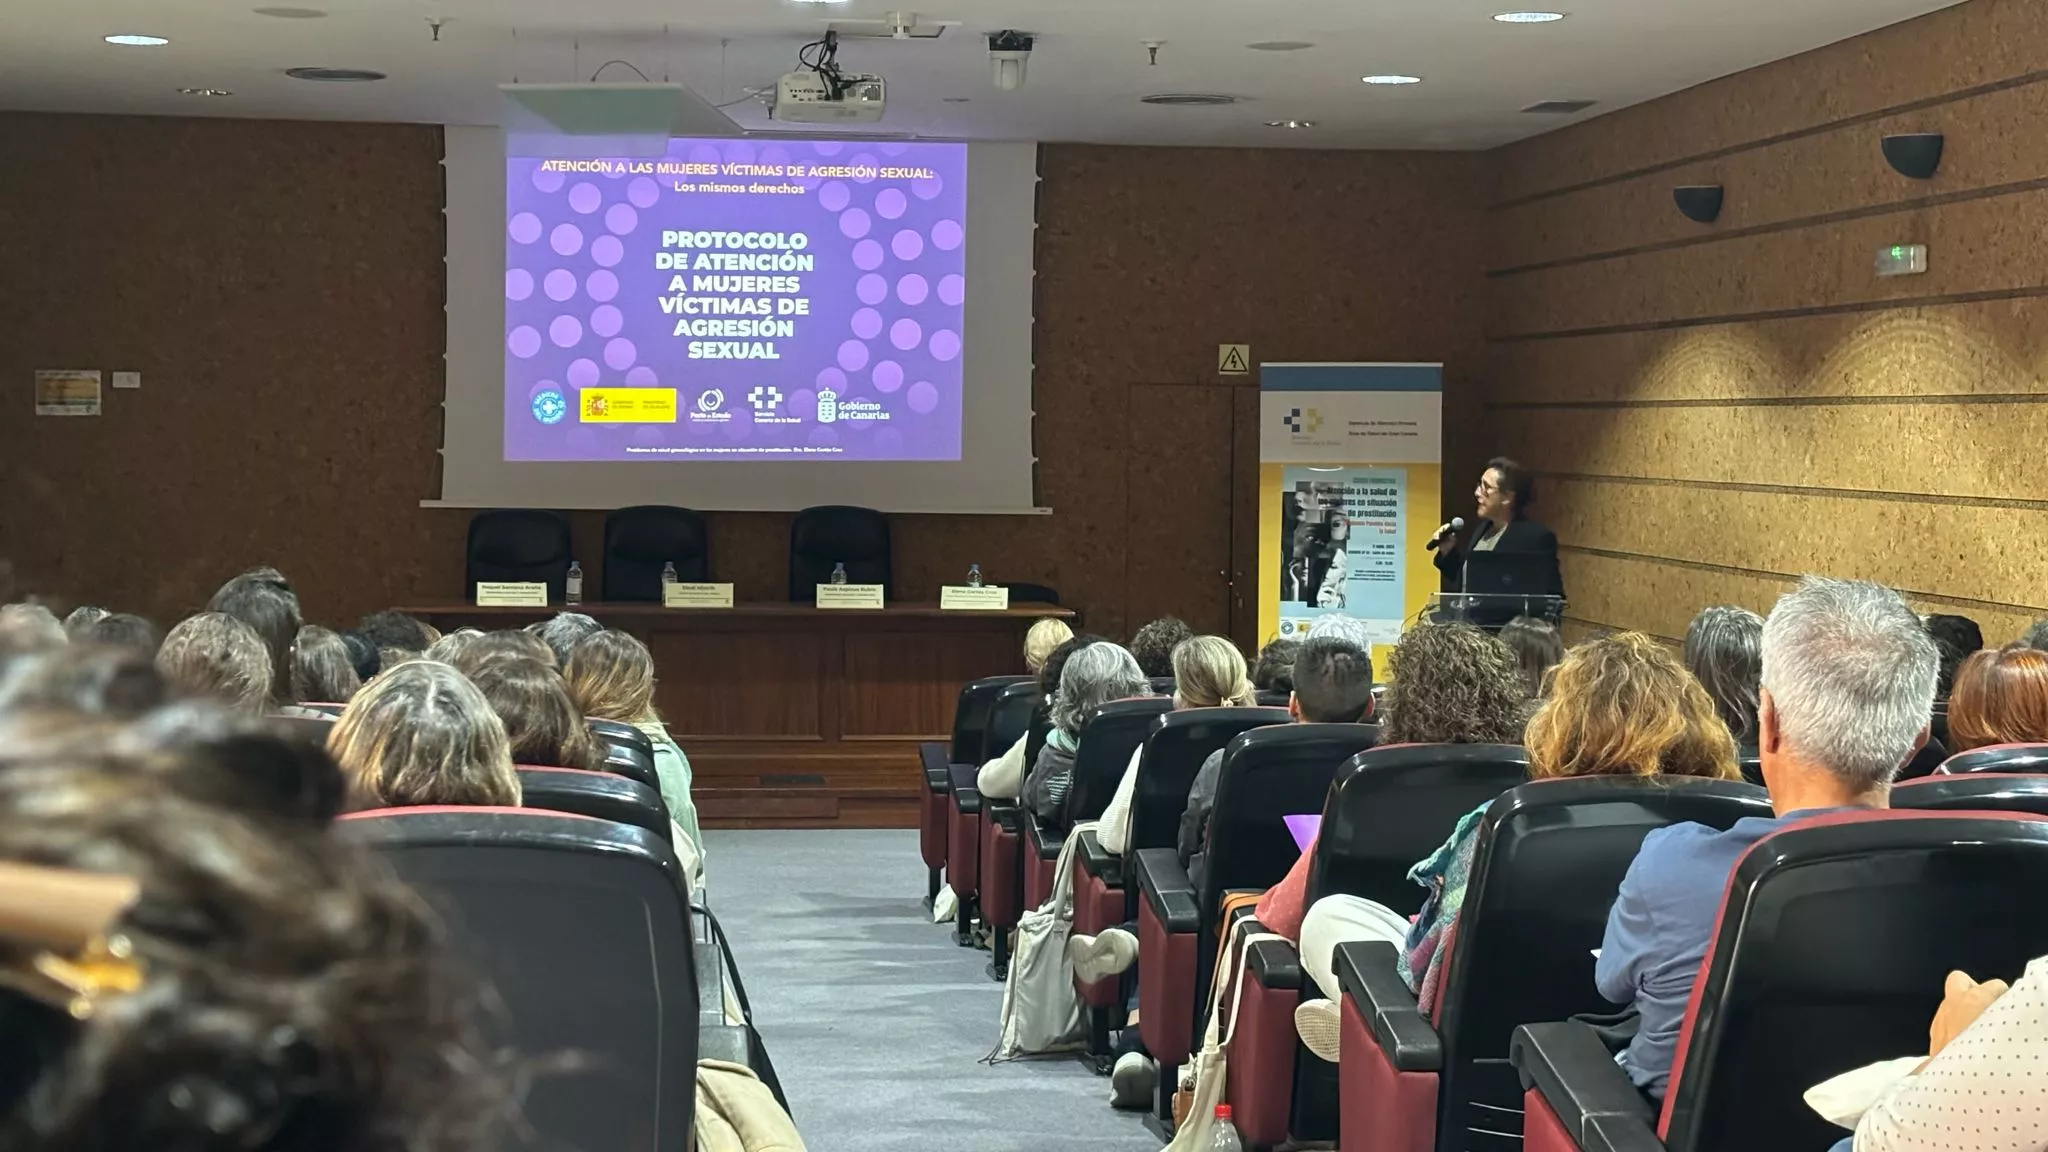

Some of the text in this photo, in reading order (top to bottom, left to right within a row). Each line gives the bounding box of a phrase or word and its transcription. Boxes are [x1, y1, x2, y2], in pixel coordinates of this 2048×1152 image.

[541, 159, 933, 178] ATENCIÓN A LAS MUJERES VÍCTIMAS DE AGRESIÓN SEXUAL:
[674, 182, 805, 194] Los mismos derechos
[662, 230, 808, 250] PROTOCOLO
[655, 250, 814, 272] DE ATENCIÓN
[668, 274, 800, 293] A MUJERES
[658, 292, 809, 315] VÍCTIMAS DE
[673, 315, 794, 337] AGRESIÓN
[688, 341, 780, 359] SEXUAL
[838, 402, 881, 411] Gobierno
[838, 412, 890, 420] de Canarias
[1370, 487, 1388, 496] salud
[1389, 488, 1397, 496] de
